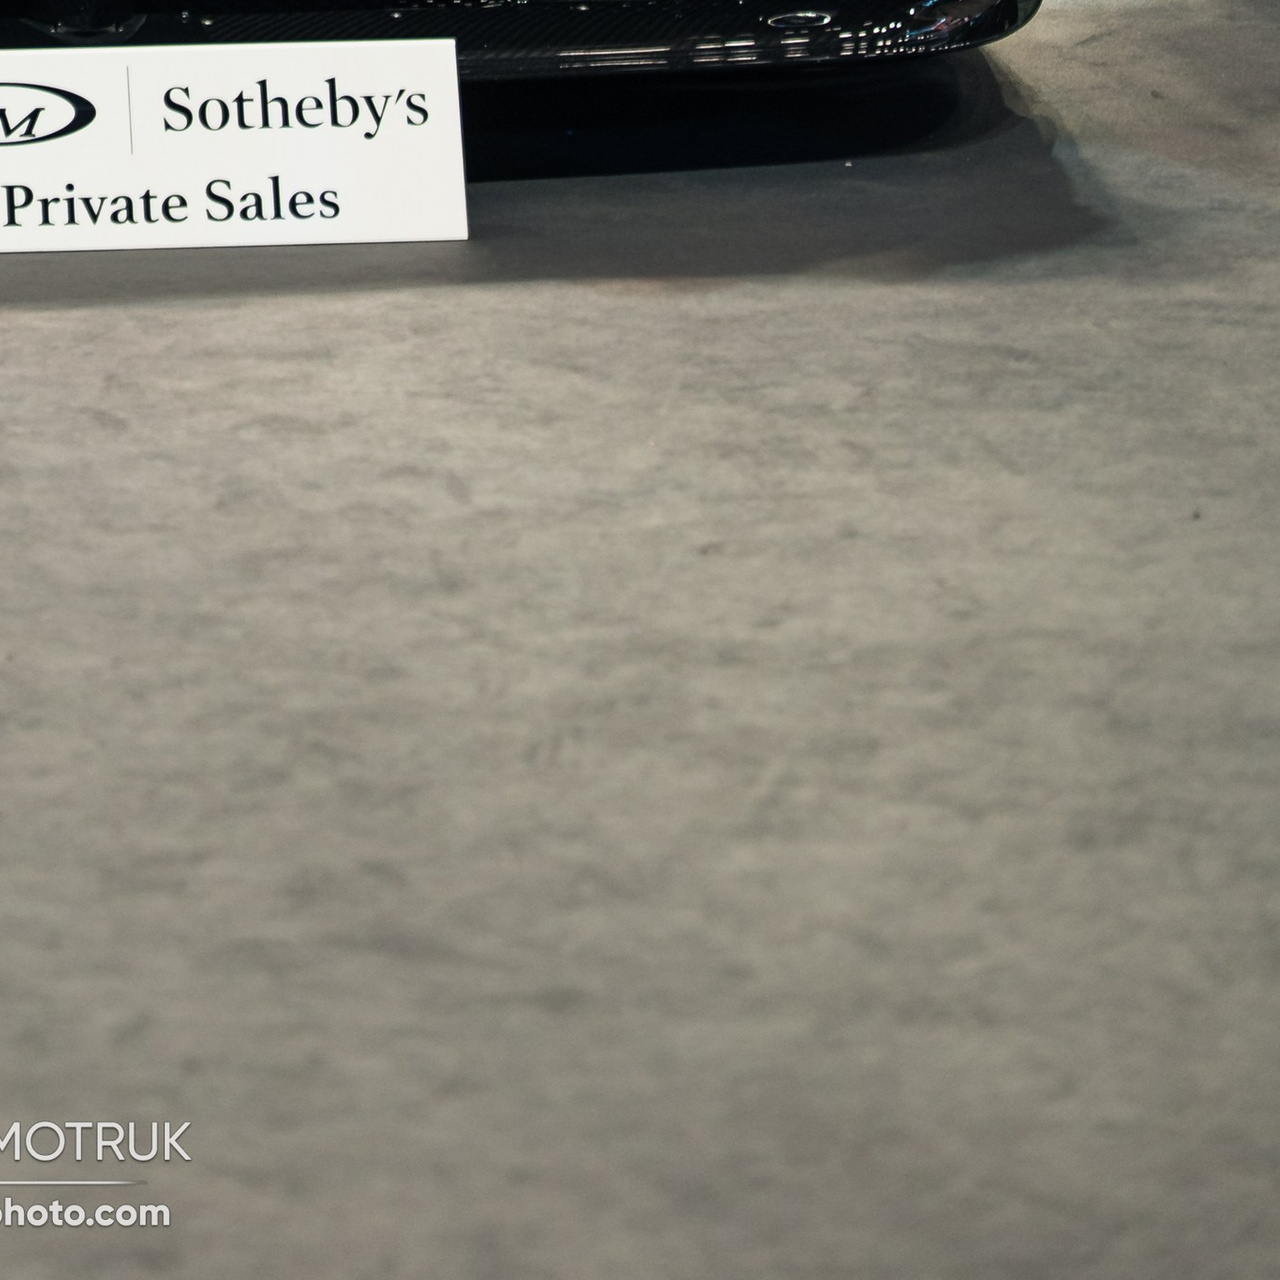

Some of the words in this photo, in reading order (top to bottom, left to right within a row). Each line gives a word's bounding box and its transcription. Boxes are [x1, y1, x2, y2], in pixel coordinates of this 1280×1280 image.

[163, 77, 429, 139] Sotheby's
[2, 183, 188, 227] Private
[205, 175, 340, 222] Sales
